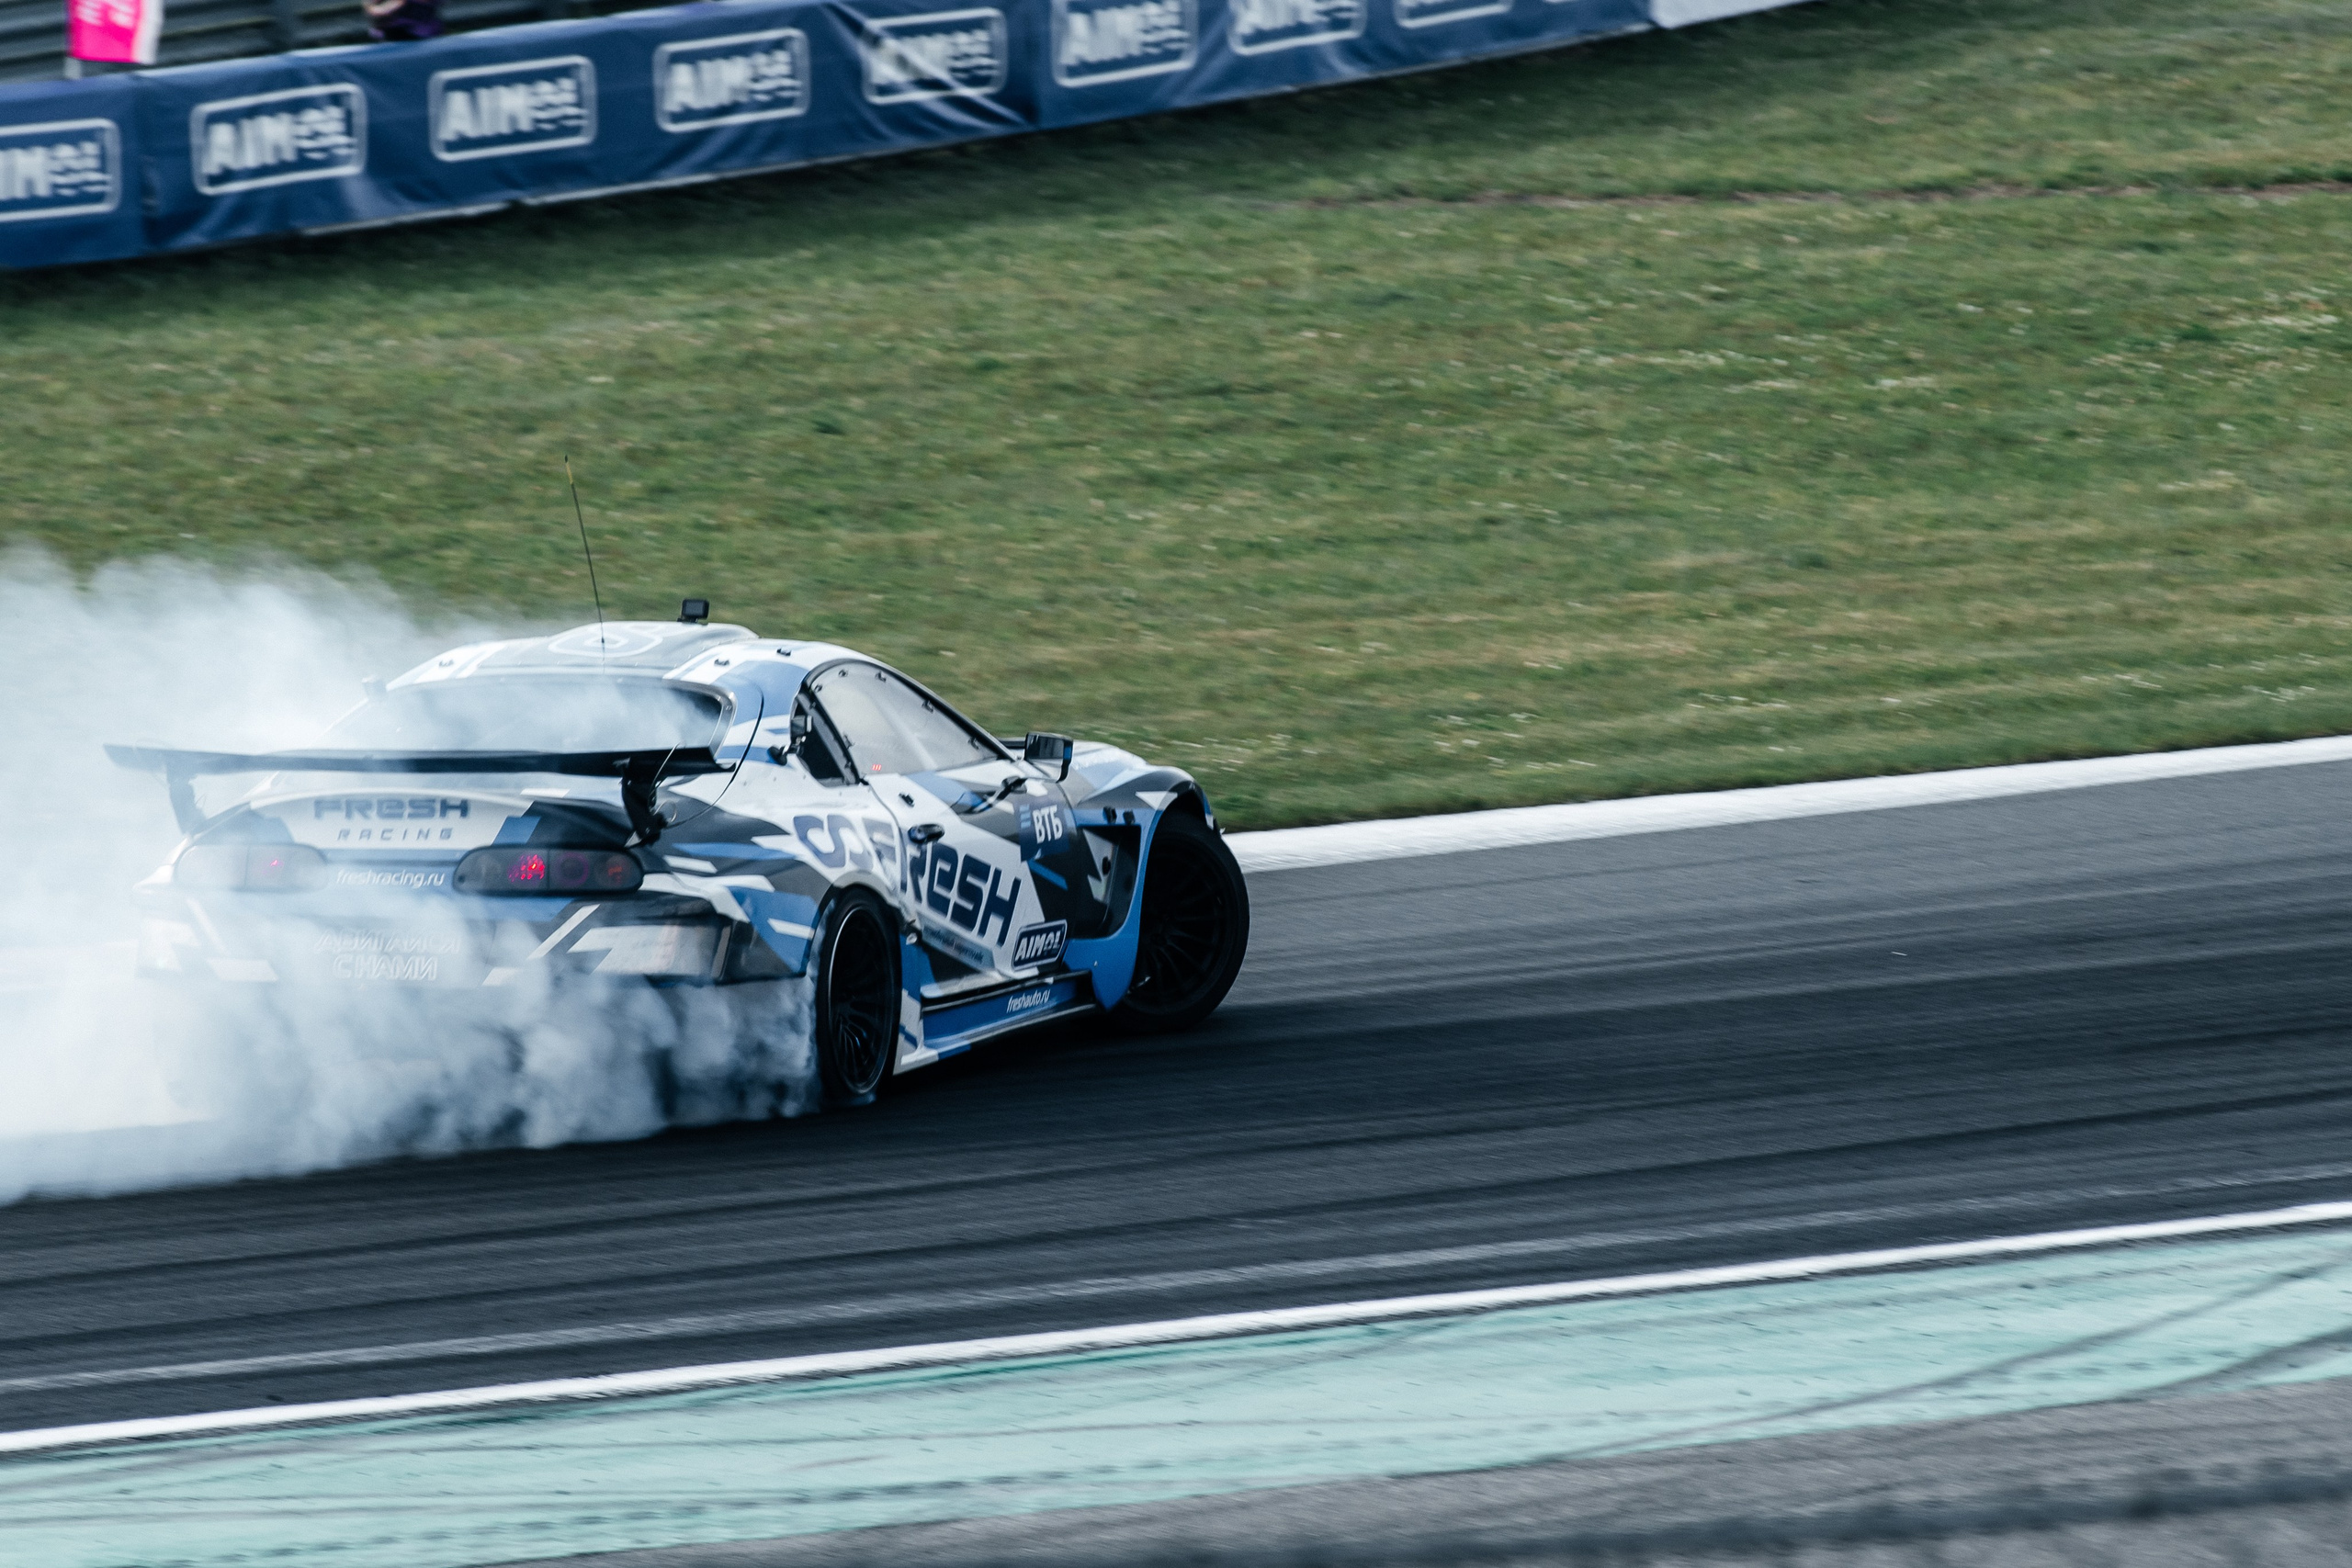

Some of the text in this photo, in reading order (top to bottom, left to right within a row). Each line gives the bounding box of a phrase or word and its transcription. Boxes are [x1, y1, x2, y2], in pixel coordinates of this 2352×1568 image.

[336, 828, 453, 840] RACING
[1032, 805, 1063, 844] ВТБ
[336, 869, 446, 888] freshracing.ru
[1006, 986, 1051, 1014] freshauto.ru
